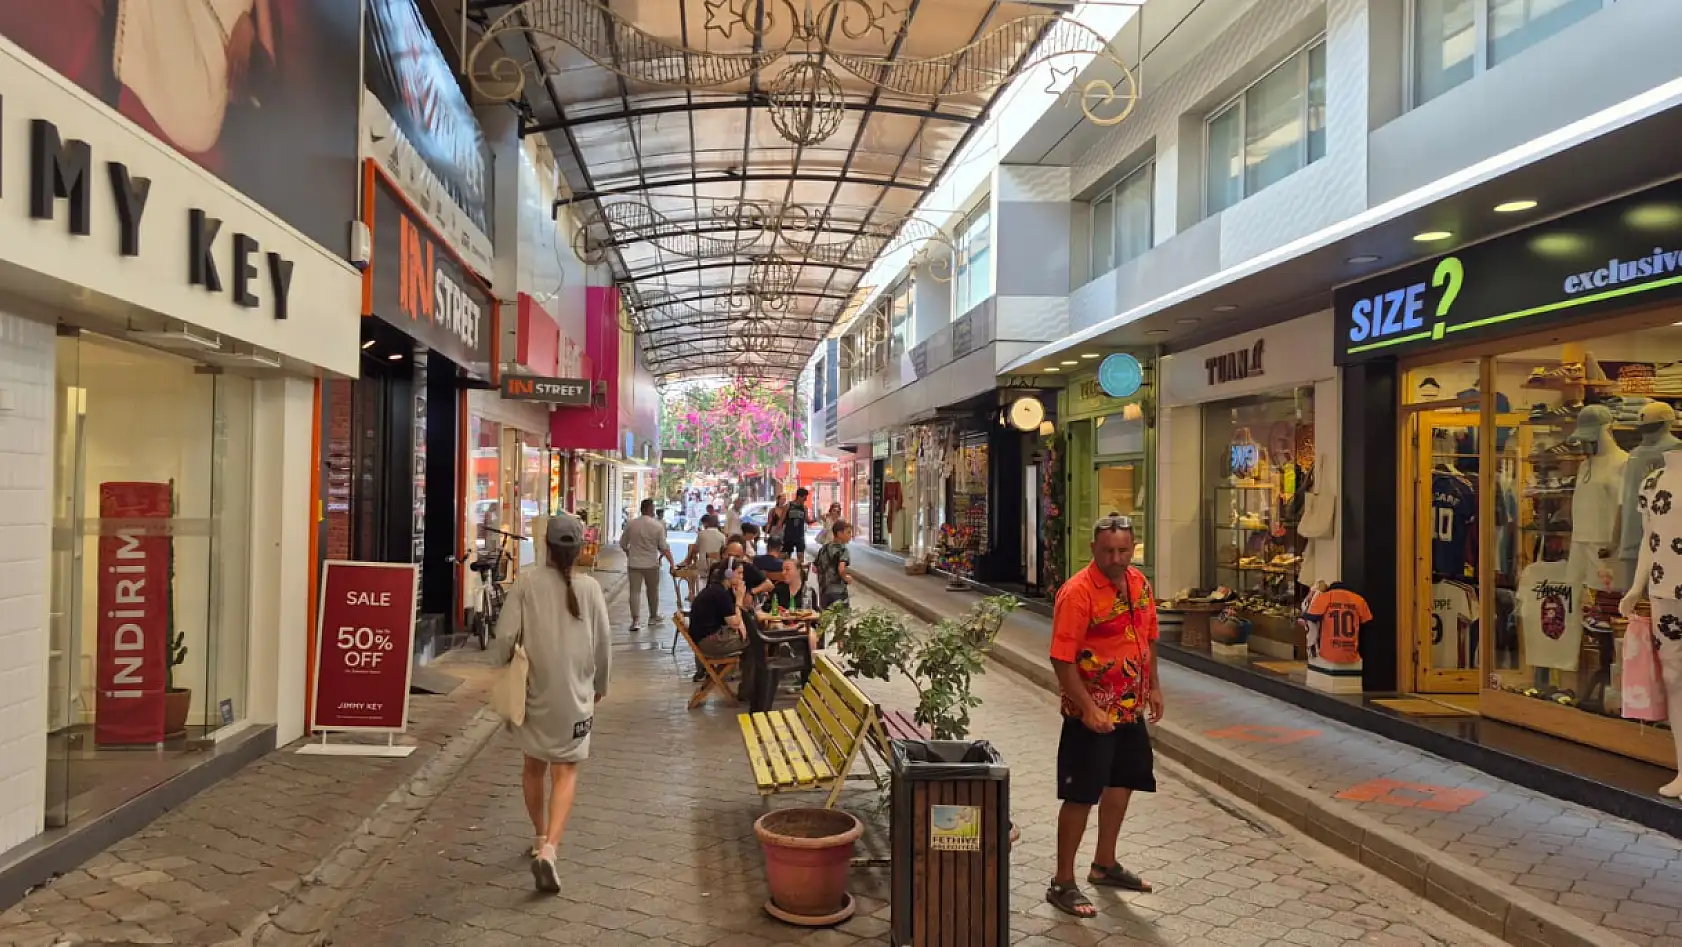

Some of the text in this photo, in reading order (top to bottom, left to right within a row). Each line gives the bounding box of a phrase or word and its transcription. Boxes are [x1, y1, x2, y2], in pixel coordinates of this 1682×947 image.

[188, 207, 294, 320] KEY
[398, 212, 434, 328] IN
[435, 267, 481, 351] STREET
[508, 379, 584, 396] IN STREET
[346, 591, 392, 607] SALE
[1329, 610, 1356, 638] 10
[337, 626, 393, 651] 50%
[344, 651, 384, 668] OFF
[337, 702, 383, 711] JIMMY KEY
